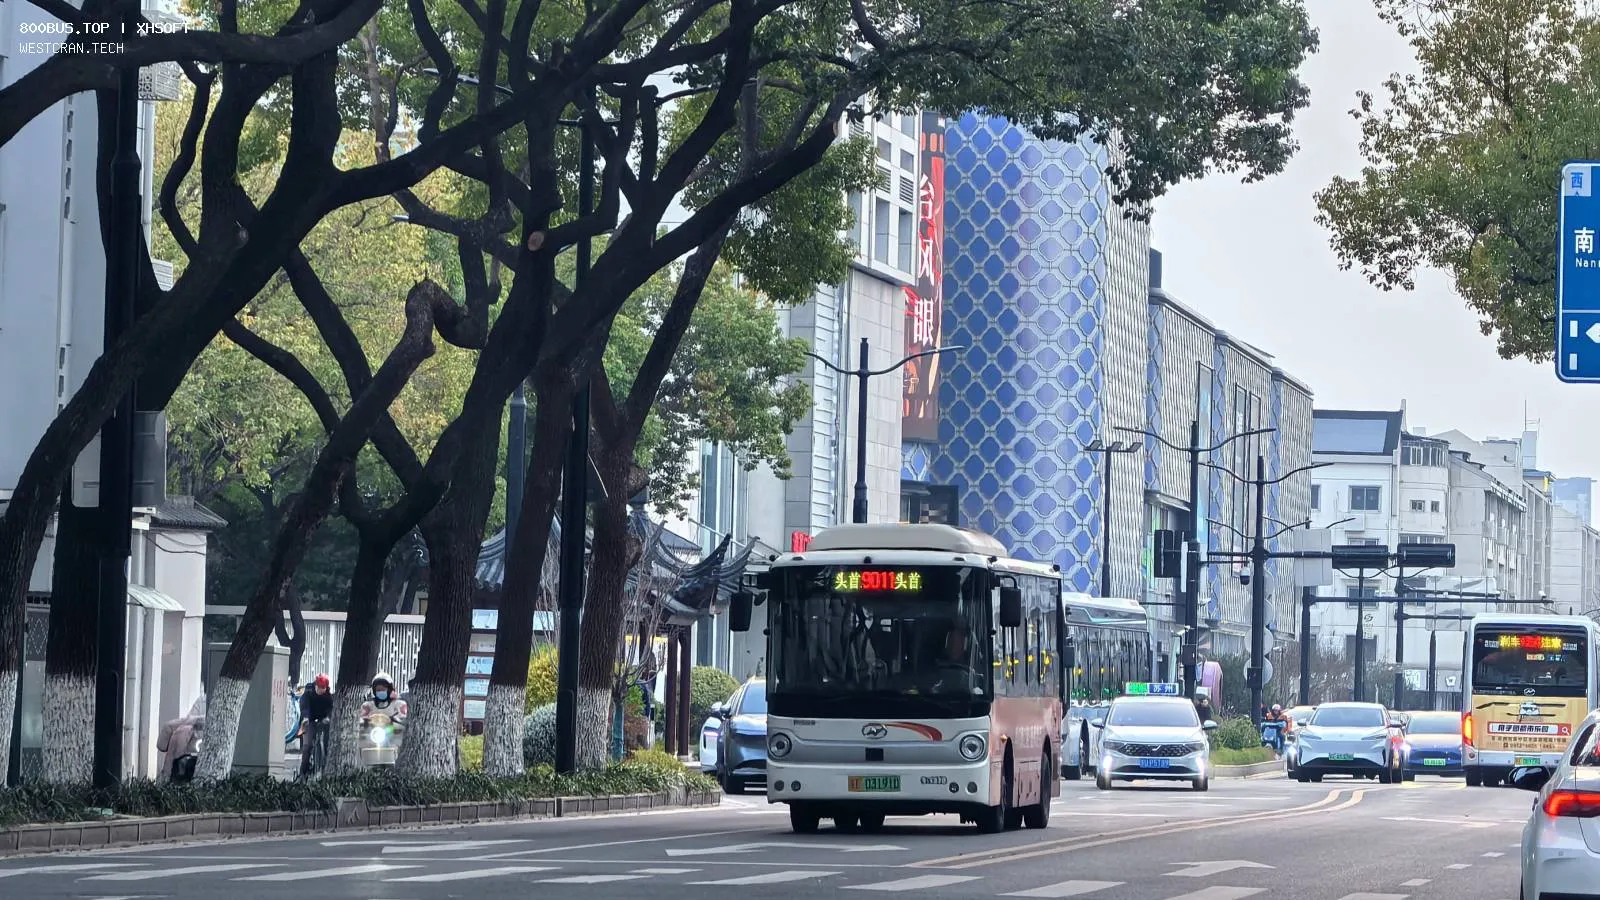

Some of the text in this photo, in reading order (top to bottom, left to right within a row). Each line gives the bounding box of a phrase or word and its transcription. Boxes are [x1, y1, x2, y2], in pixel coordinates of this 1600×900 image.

[1570, 172, 1584, 189] 西
[913, 173, 935, 346] 台风眼
[1575, 257, 1600, 268] Nan
[862, 571, 895, 590] 9011
